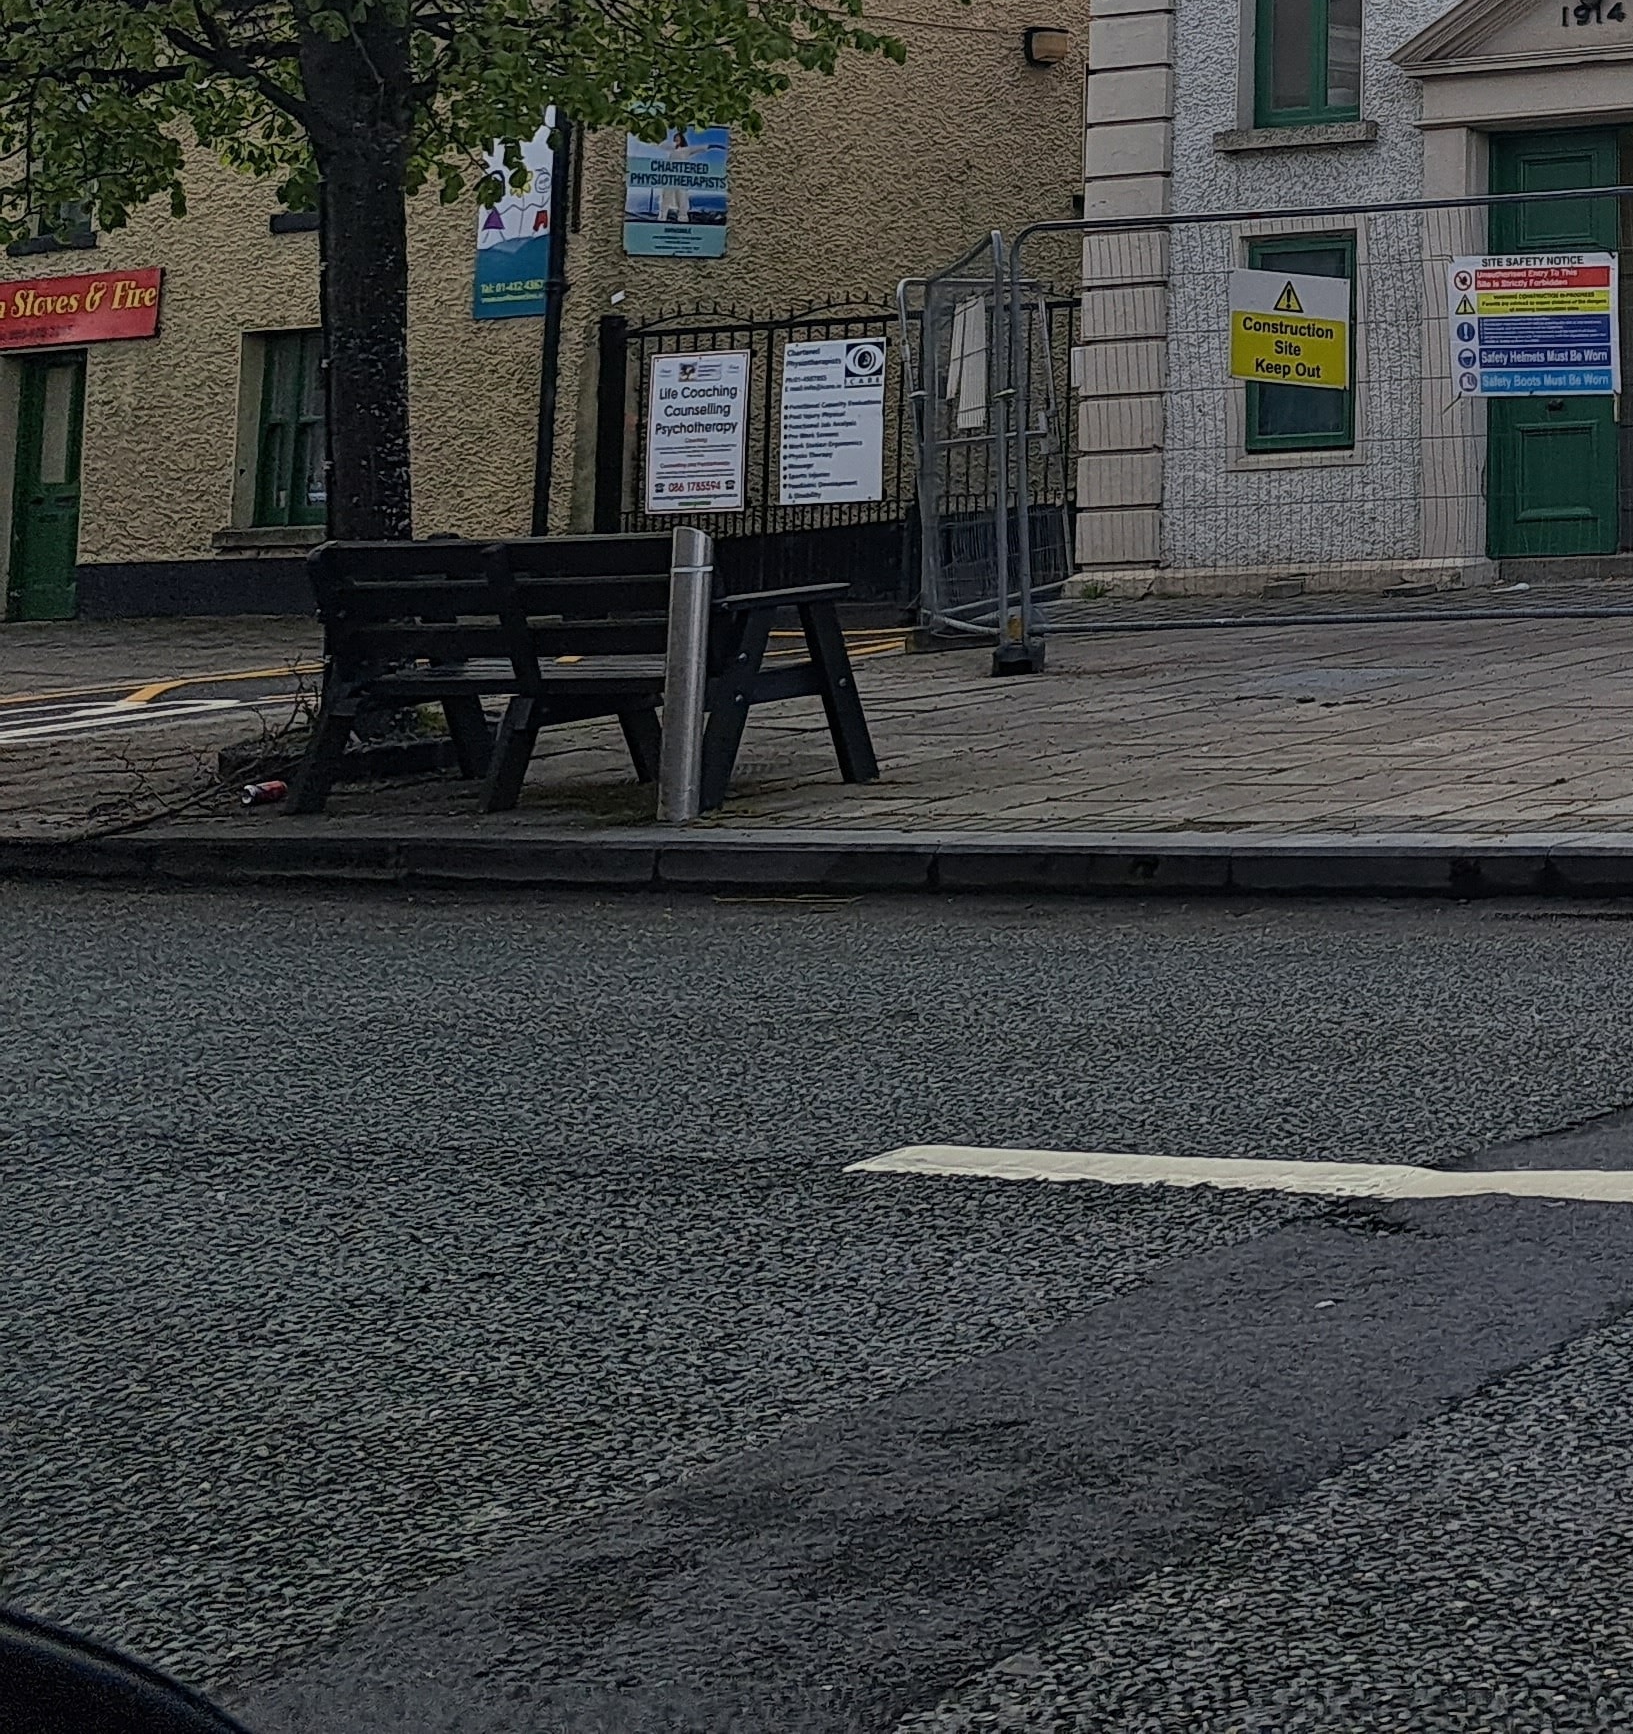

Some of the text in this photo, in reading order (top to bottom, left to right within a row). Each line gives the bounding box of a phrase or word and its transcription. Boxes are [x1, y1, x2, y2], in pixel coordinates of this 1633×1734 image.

[1562, 2, 1626, 27] 1914
[651, 160, 709, 174] CHARTERED
[630, 172, 727, 189] PHYSIOTHERAPISTS
[1482, 255, 1584, 267] SITE SAFETY NOTICE
[1528, 270, 1549, 278] Entry
[1501, 279, 1527, 288] Strictly
[1529, 278, 1568, 286] Forbidden
[11, 289, 80, 318] Stoves
[85, 281, 107, 312] &
[112, 280, 157, 310] Fire
[1242, 316, 1334, 340] Construction
[1274, 340, 1301, 356] Site
[1482, 349, 1608, 365] Safety Helmets Must Be Worn
[1255, 358, 1321, 378] Keep Out
[1482, 373, 1609, 389] Safety Boots Must Be Worn
[659, 385, 737, 400] Life Coaching
[664, 403, 731, 417] Counselling
[655, 422, 738, 436] Psychotherapy
